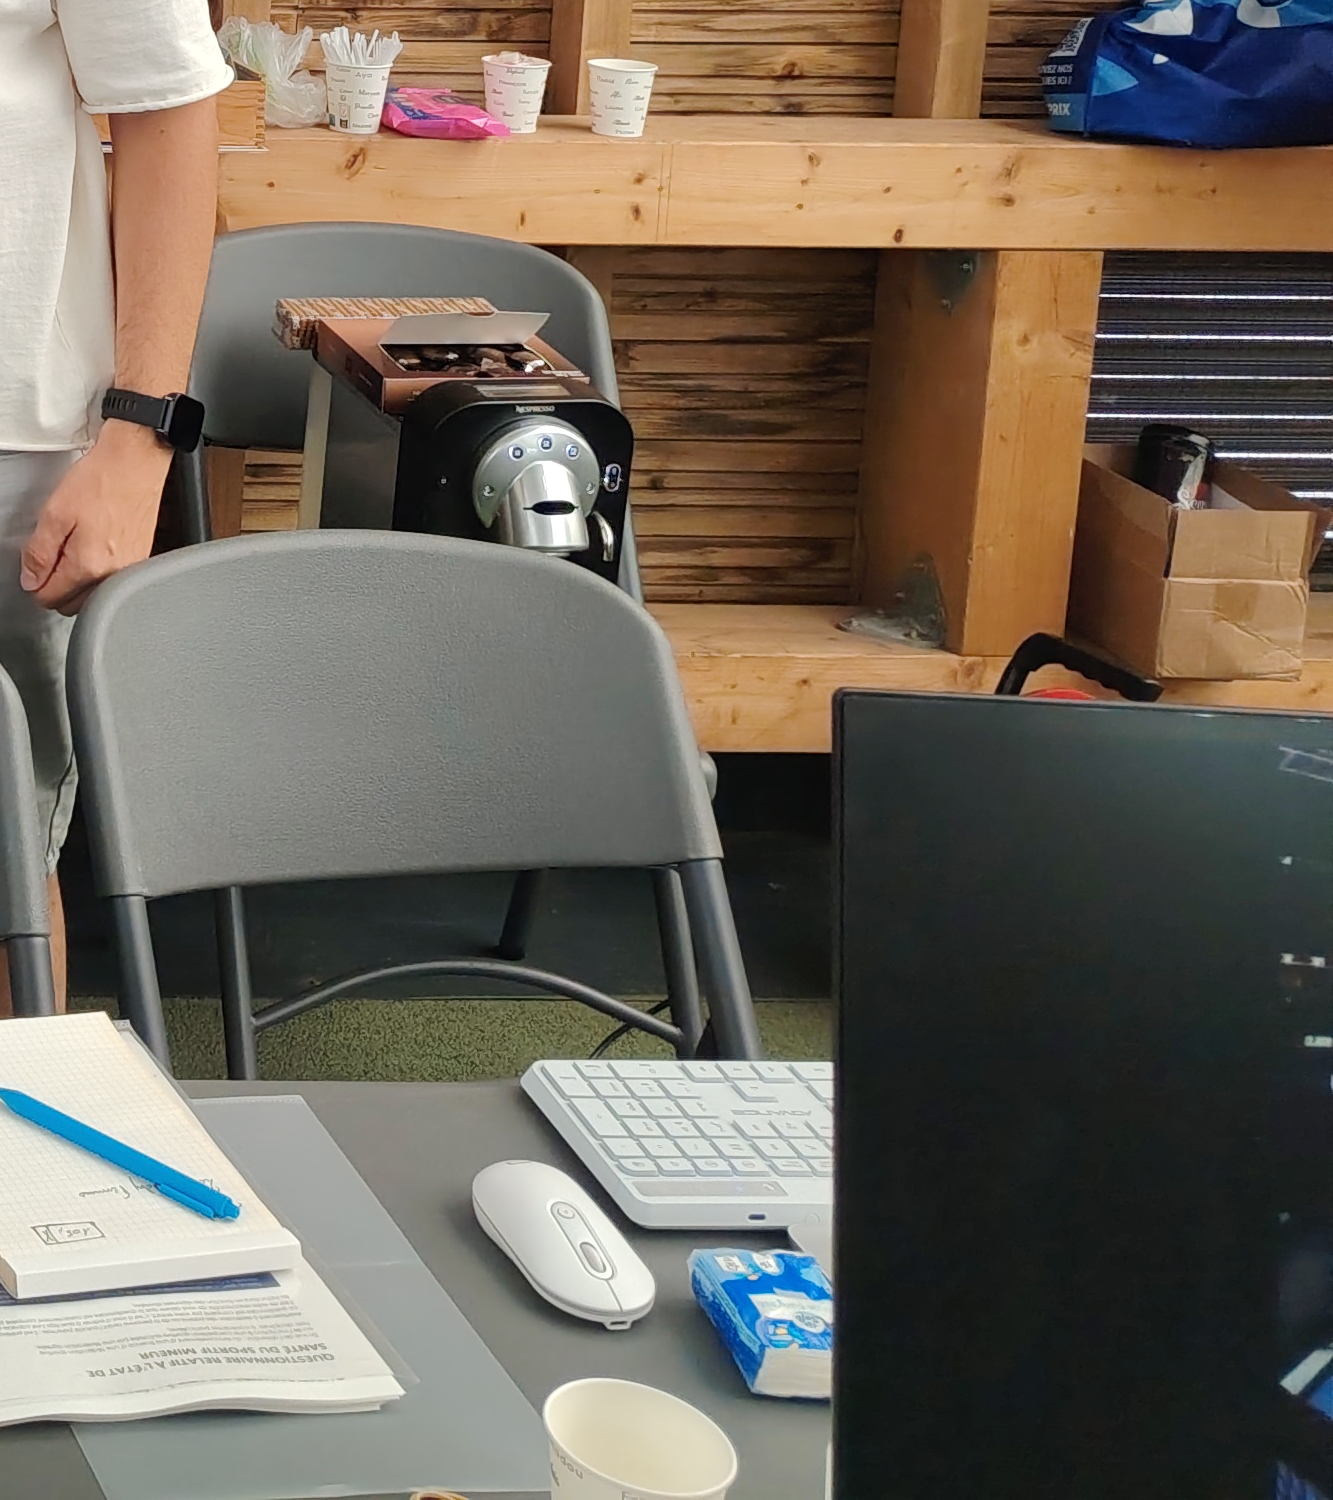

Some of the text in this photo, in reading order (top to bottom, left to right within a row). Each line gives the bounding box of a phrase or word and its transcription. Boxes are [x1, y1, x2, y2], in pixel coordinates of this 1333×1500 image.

[138, 1342, 328, 1361] SANTÉ DU SPORTIF MINEUR
[167, 1355, 220, 1367] RELATIF
[220, 1353, 334, 1366] QUESTIONNAIRE
[86, 1368, 107, 1379] DE
